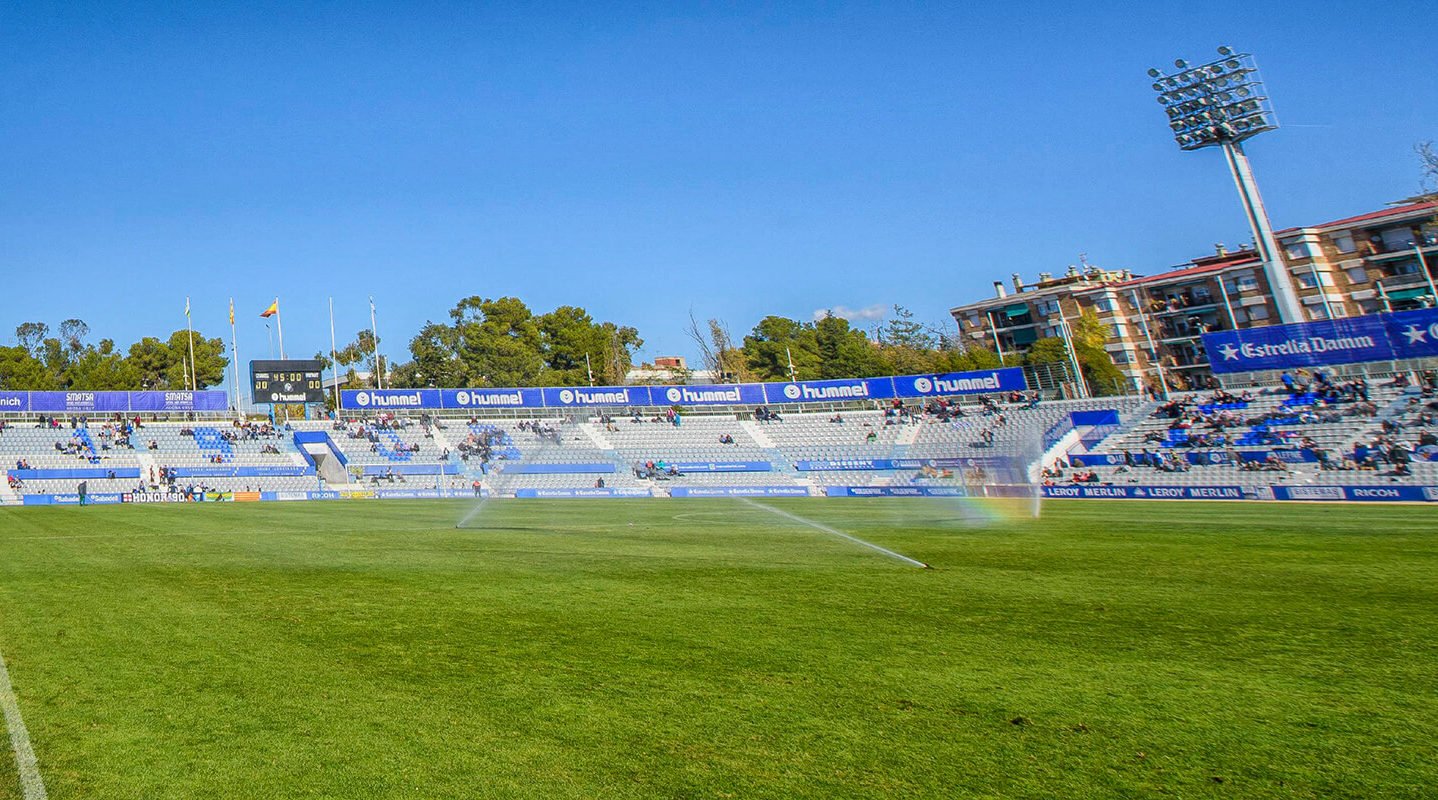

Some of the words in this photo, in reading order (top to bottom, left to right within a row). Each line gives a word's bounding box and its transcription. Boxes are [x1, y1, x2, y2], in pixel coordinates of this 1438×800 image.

[1241, 336, 1310, 358] Estrella
[1310, 335, 1375, 353] Damm
[934, 373, 1001, 392] hummel
[683, 387, 742, 402] hummel
[804, 381, 869, 398] hummel
[66, 392, 94, 401] SMATSA
[165, 392, 193, 401] SMATSA
[279, 392, 306, 401] hummel
[371, 392, 422, 406] hummel
[472, 391, 523, 405] hummel
[575, 388, 630, 404] hummel
[132, 493, 167, 502] HONOR
[1048, 487, 1080, 497] LEROY
[1084, 487, 1126, 497] MERLIN
[1148, 487, 1184, 497] LEROY
[1190, 487, 1239, 497] MERLIN
[1353, 488, 1399, 497] RICOH
